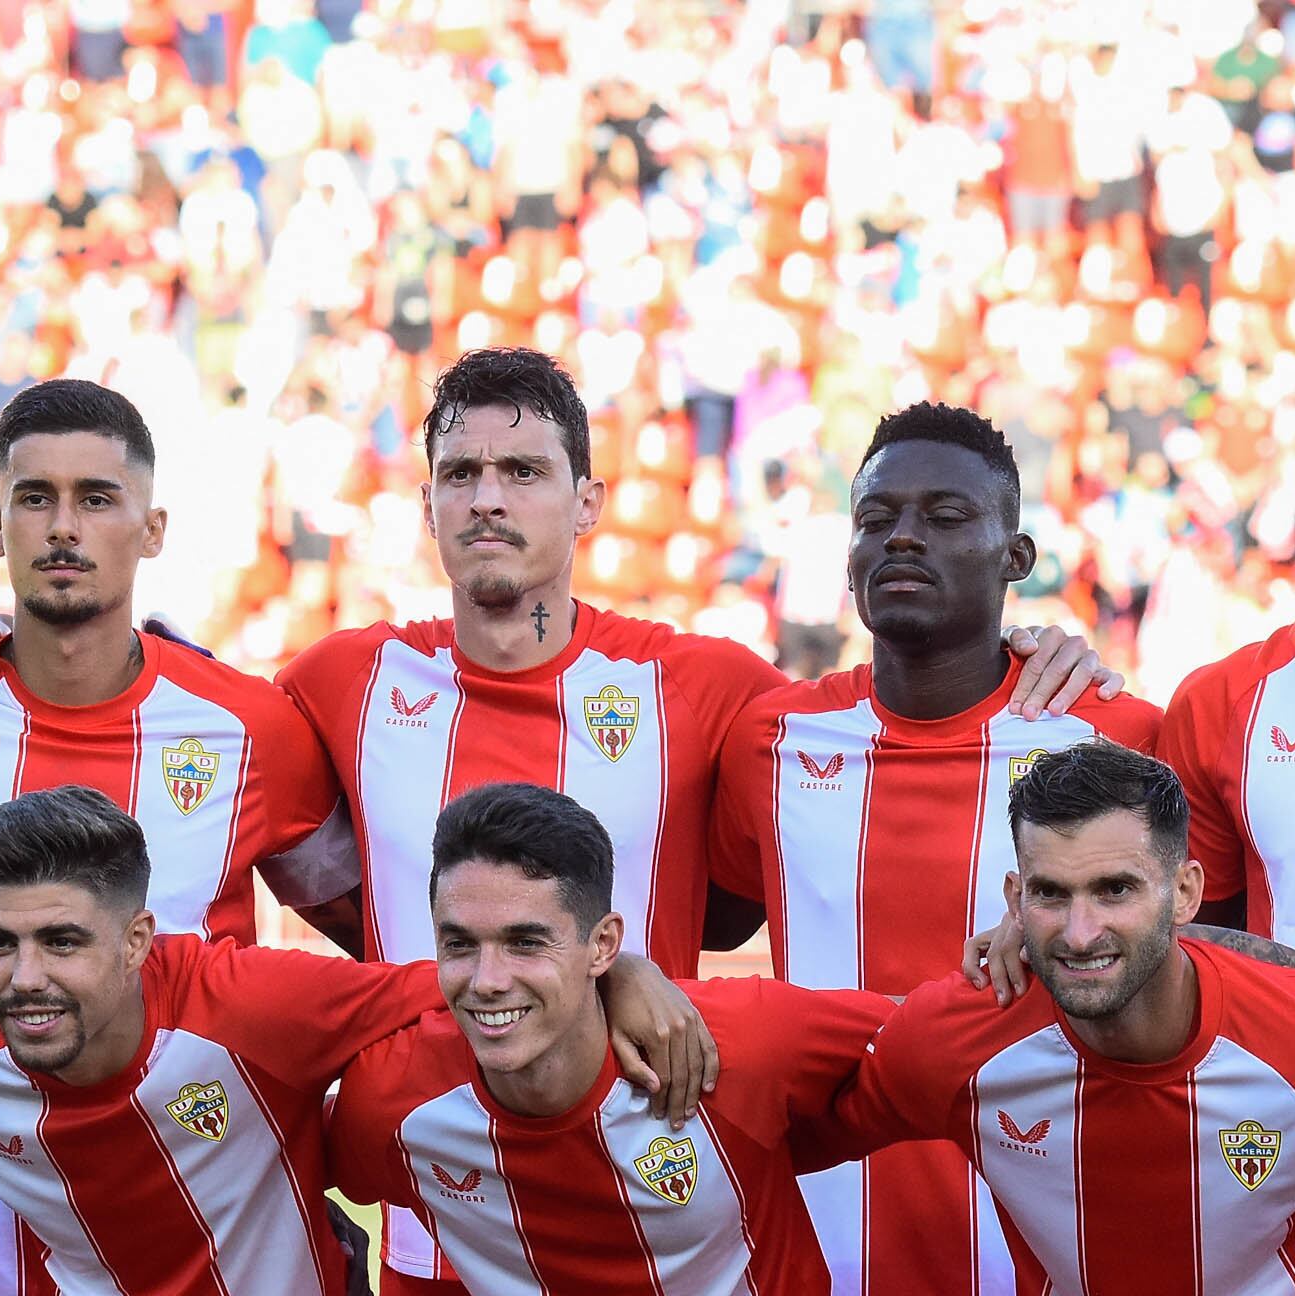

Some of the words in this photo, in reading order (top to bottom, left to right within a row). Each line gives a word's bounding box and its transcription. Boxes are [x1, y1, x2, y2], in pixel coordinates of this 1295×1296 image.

[385, 718, 428, 728] CASTORE
[591, 718, 633, 726] ALMERIA
[168, 768, 210, 780] ALMERIA
[800, 782, 842, 791] CASTORE
[182, 1098, 223, 1122] ALMERIA
[999, 1141, 1048, 1157] CASTORE
[1228, 1148, 1274, 1156] ALMERIA
[650, 1159, 692, 1180] ALMERIA
[440, 1190, 485, 1203] CASTORE
